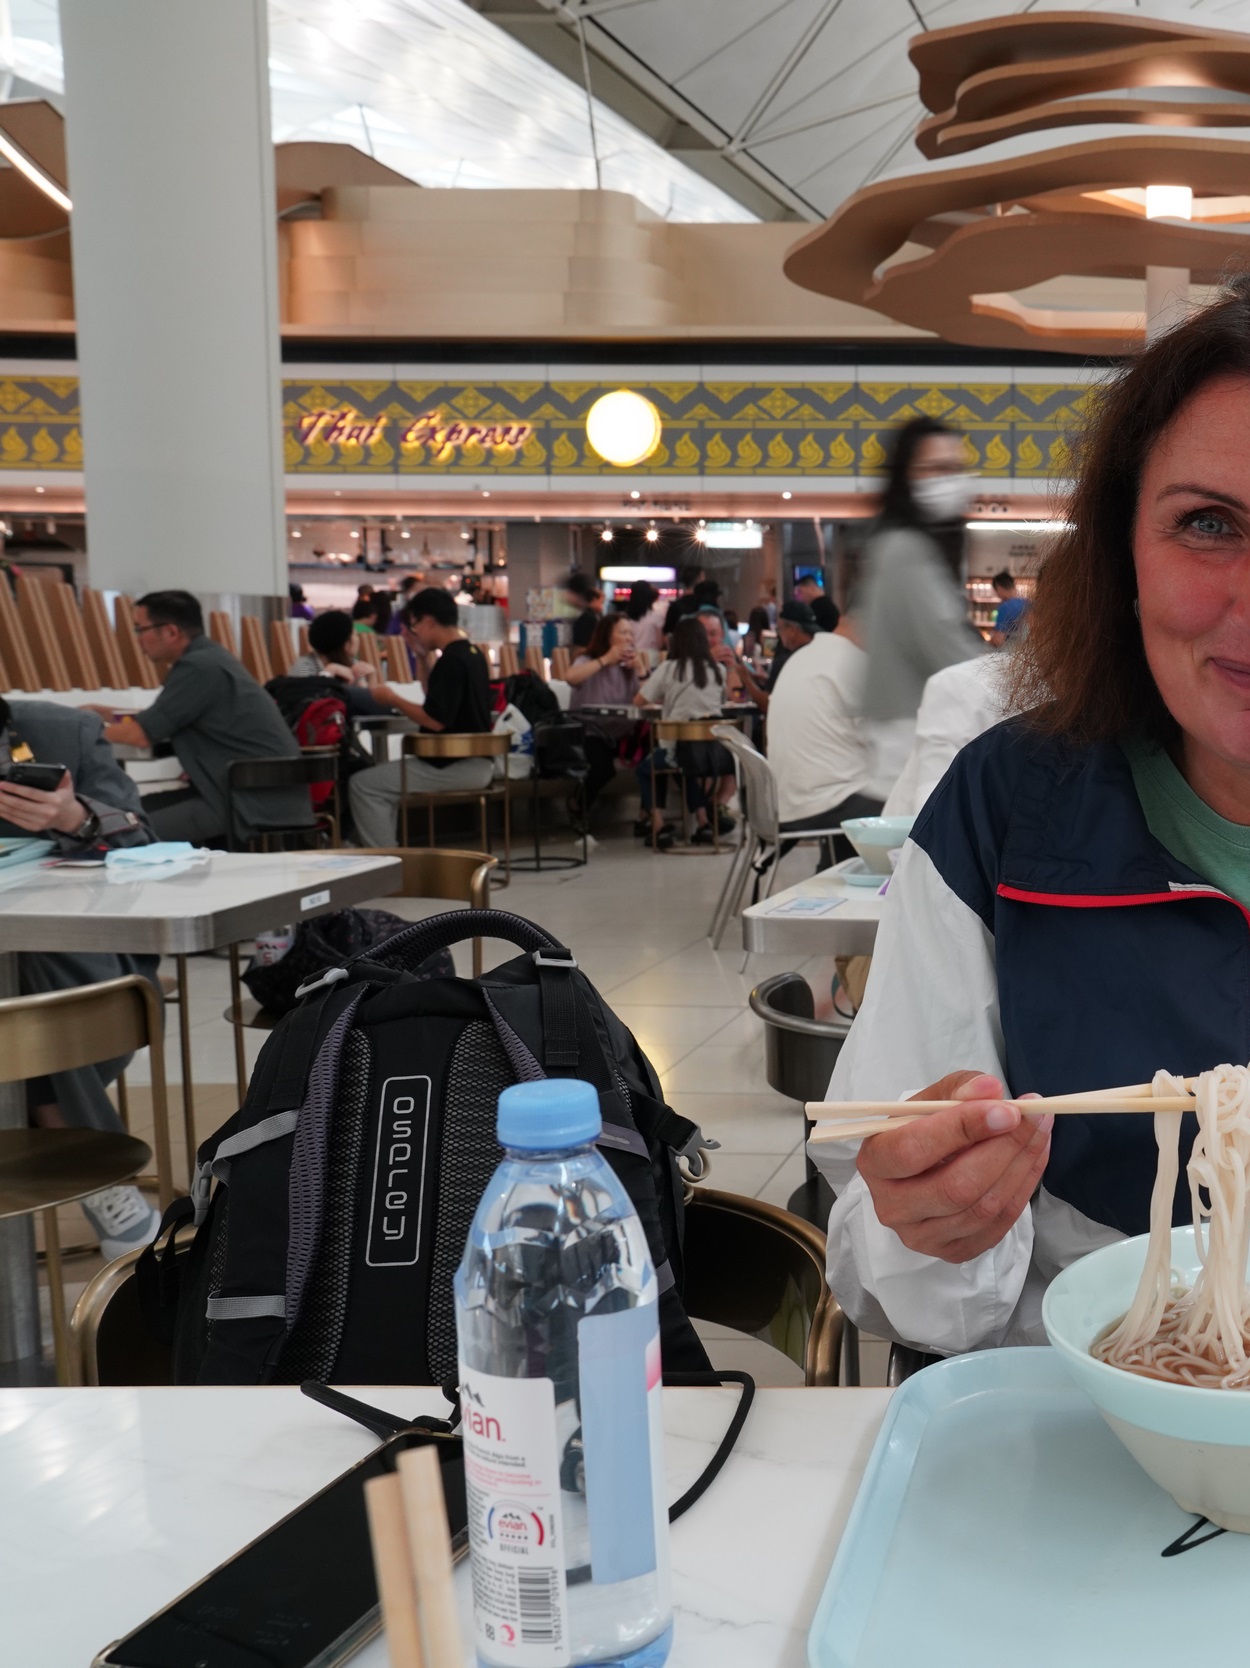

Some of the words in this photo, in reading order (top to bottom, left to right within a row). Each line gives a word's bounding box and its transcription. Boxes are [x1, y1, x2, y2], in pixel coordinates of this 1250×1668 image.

[299, 407, 387, 446] Thai
[401, 408, 533, 461] Express
[382, 1096, 415, 1241] osprey
